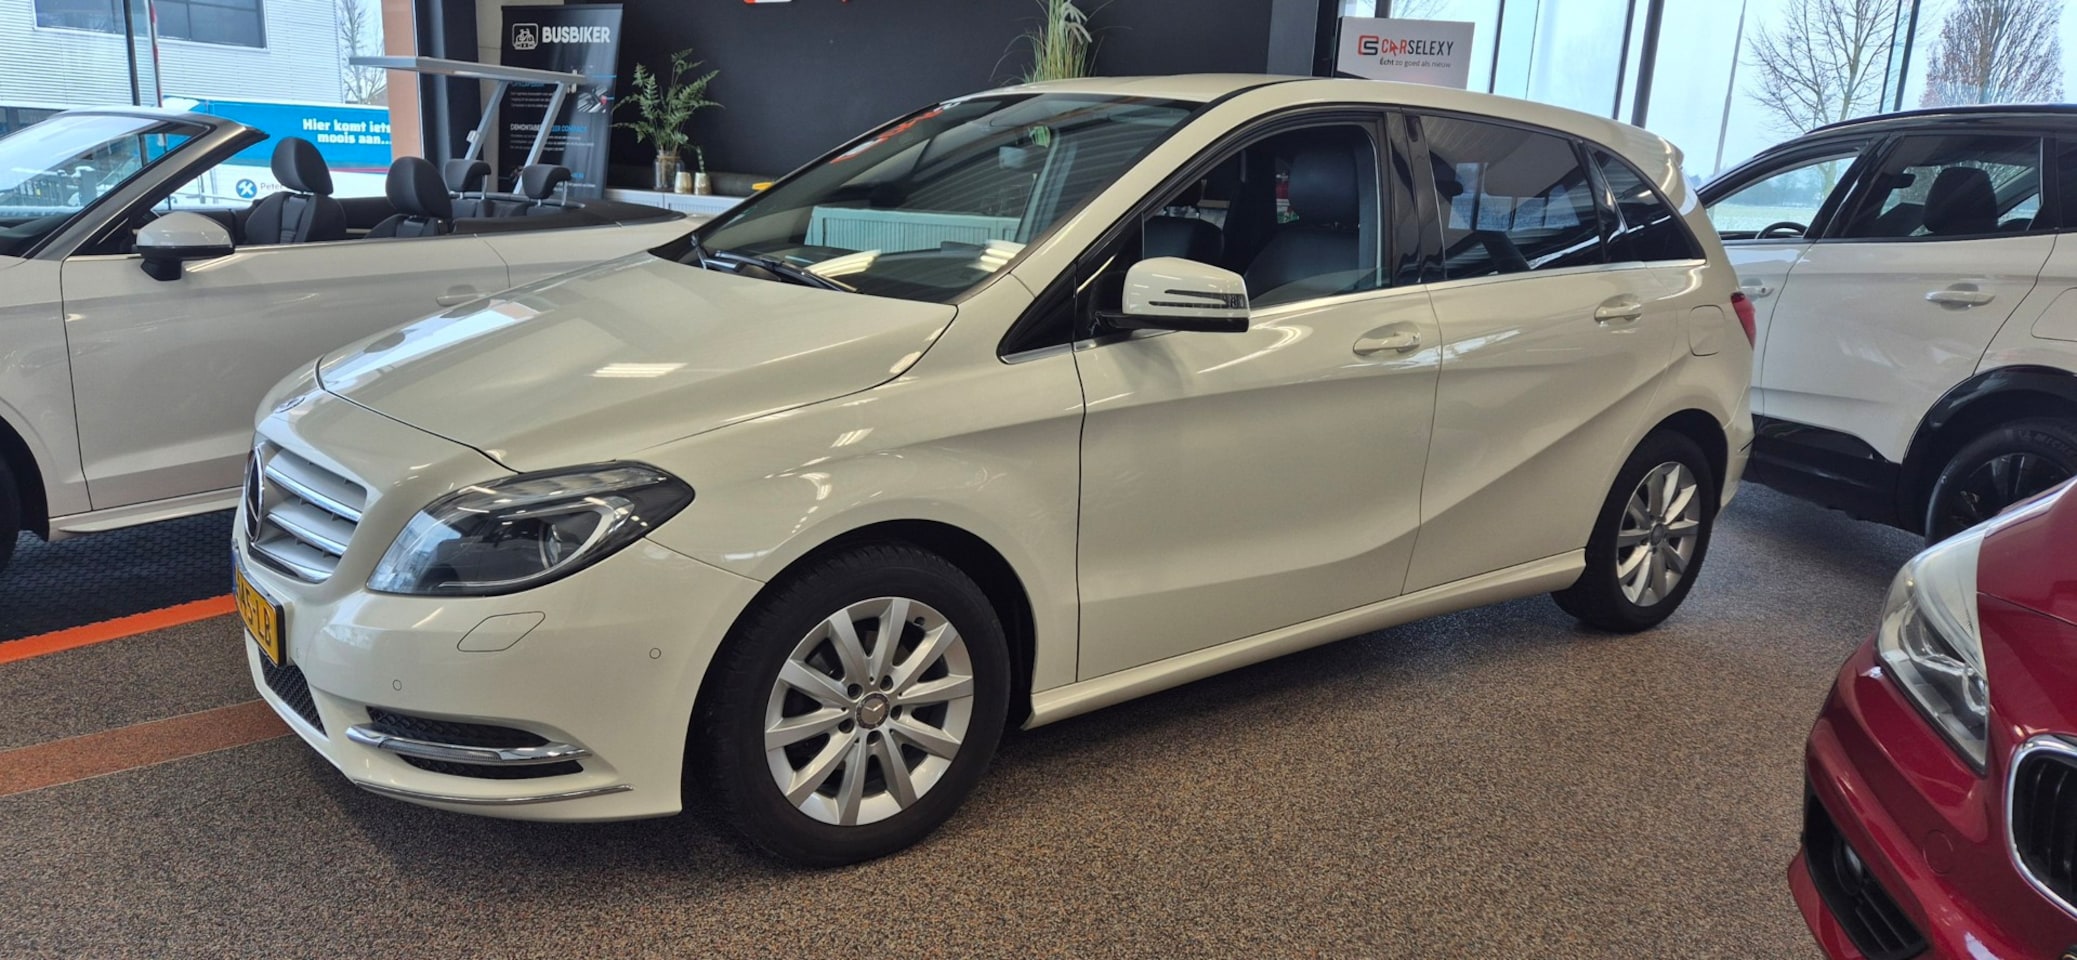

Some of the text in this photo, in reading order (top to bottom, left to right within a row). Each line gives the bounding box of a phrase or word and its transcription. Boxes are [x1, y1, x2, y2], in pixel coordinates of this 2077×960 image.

[542, 26, 611, 43] BUSBIKER
[1381, 38, 1454, 56] CARSELEXY
[302, 118, 391, 134] Hier komt iets
[317, 132, 355, 144] moois
